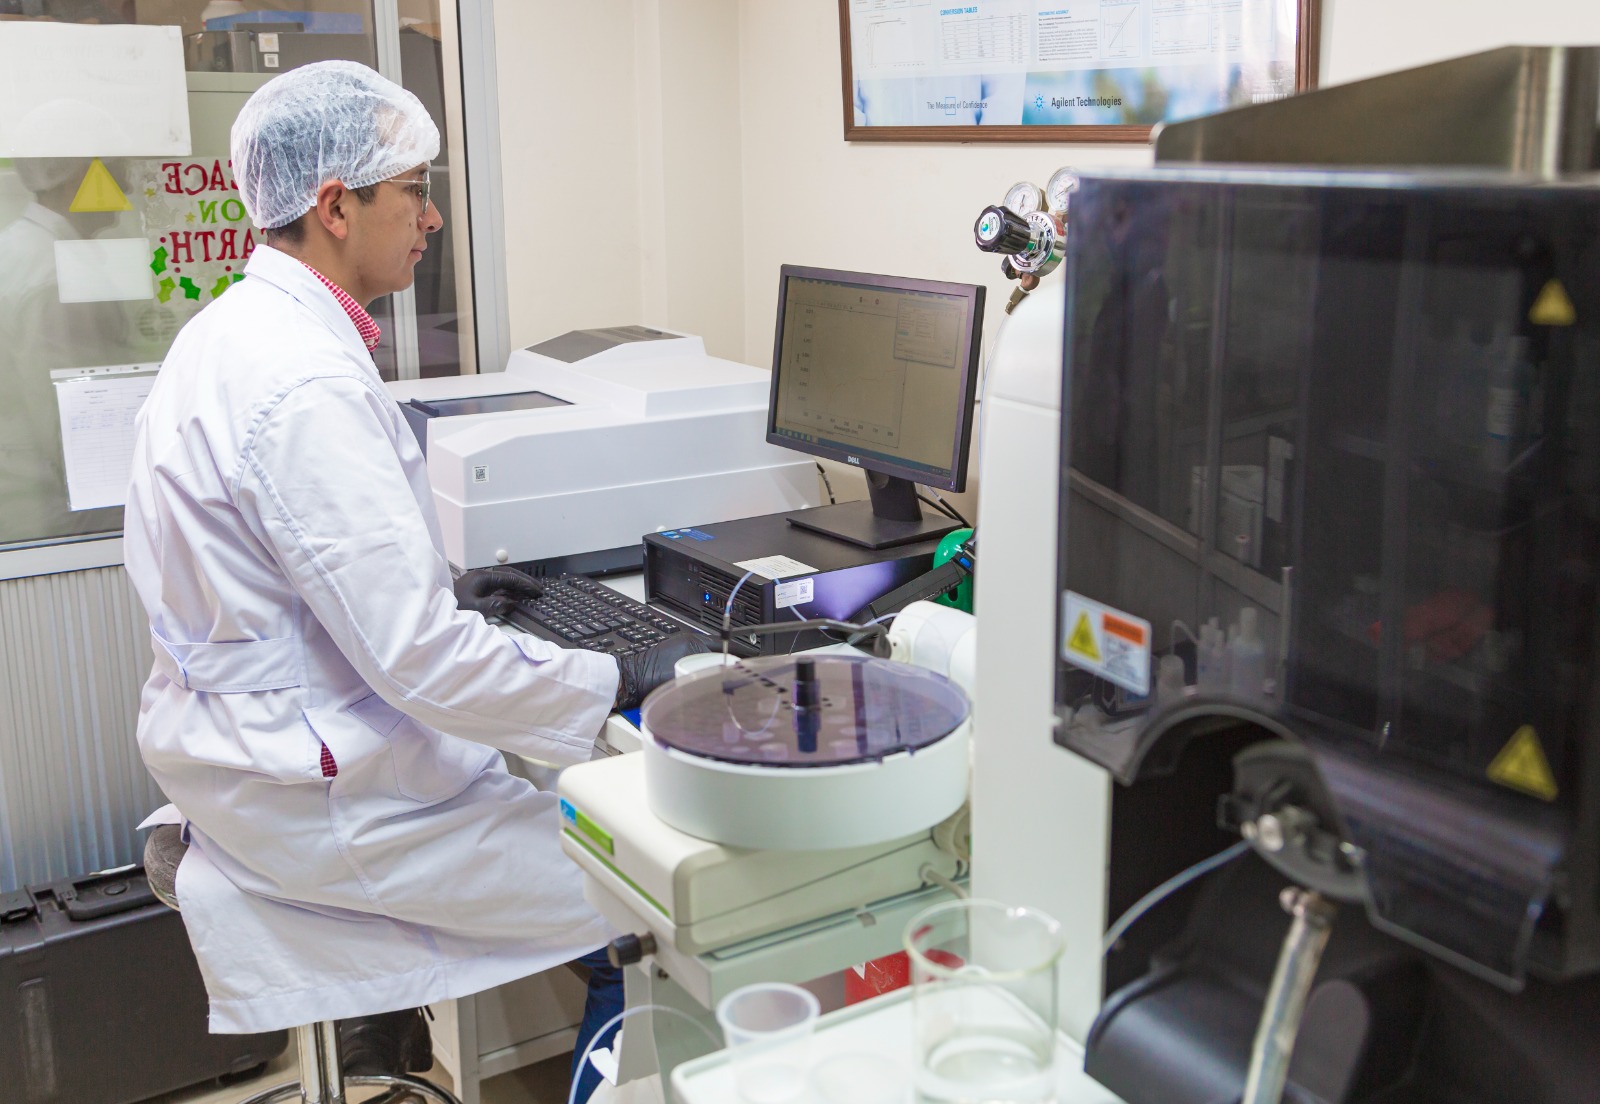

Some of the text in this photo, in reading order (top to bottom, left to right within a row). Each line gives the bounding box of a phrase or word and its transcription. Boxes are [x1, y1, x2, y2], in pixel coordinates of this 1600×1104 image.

[1051, 96, 1122, 109] Agilent Technologies
[848, 456, 860, 464] DELL
